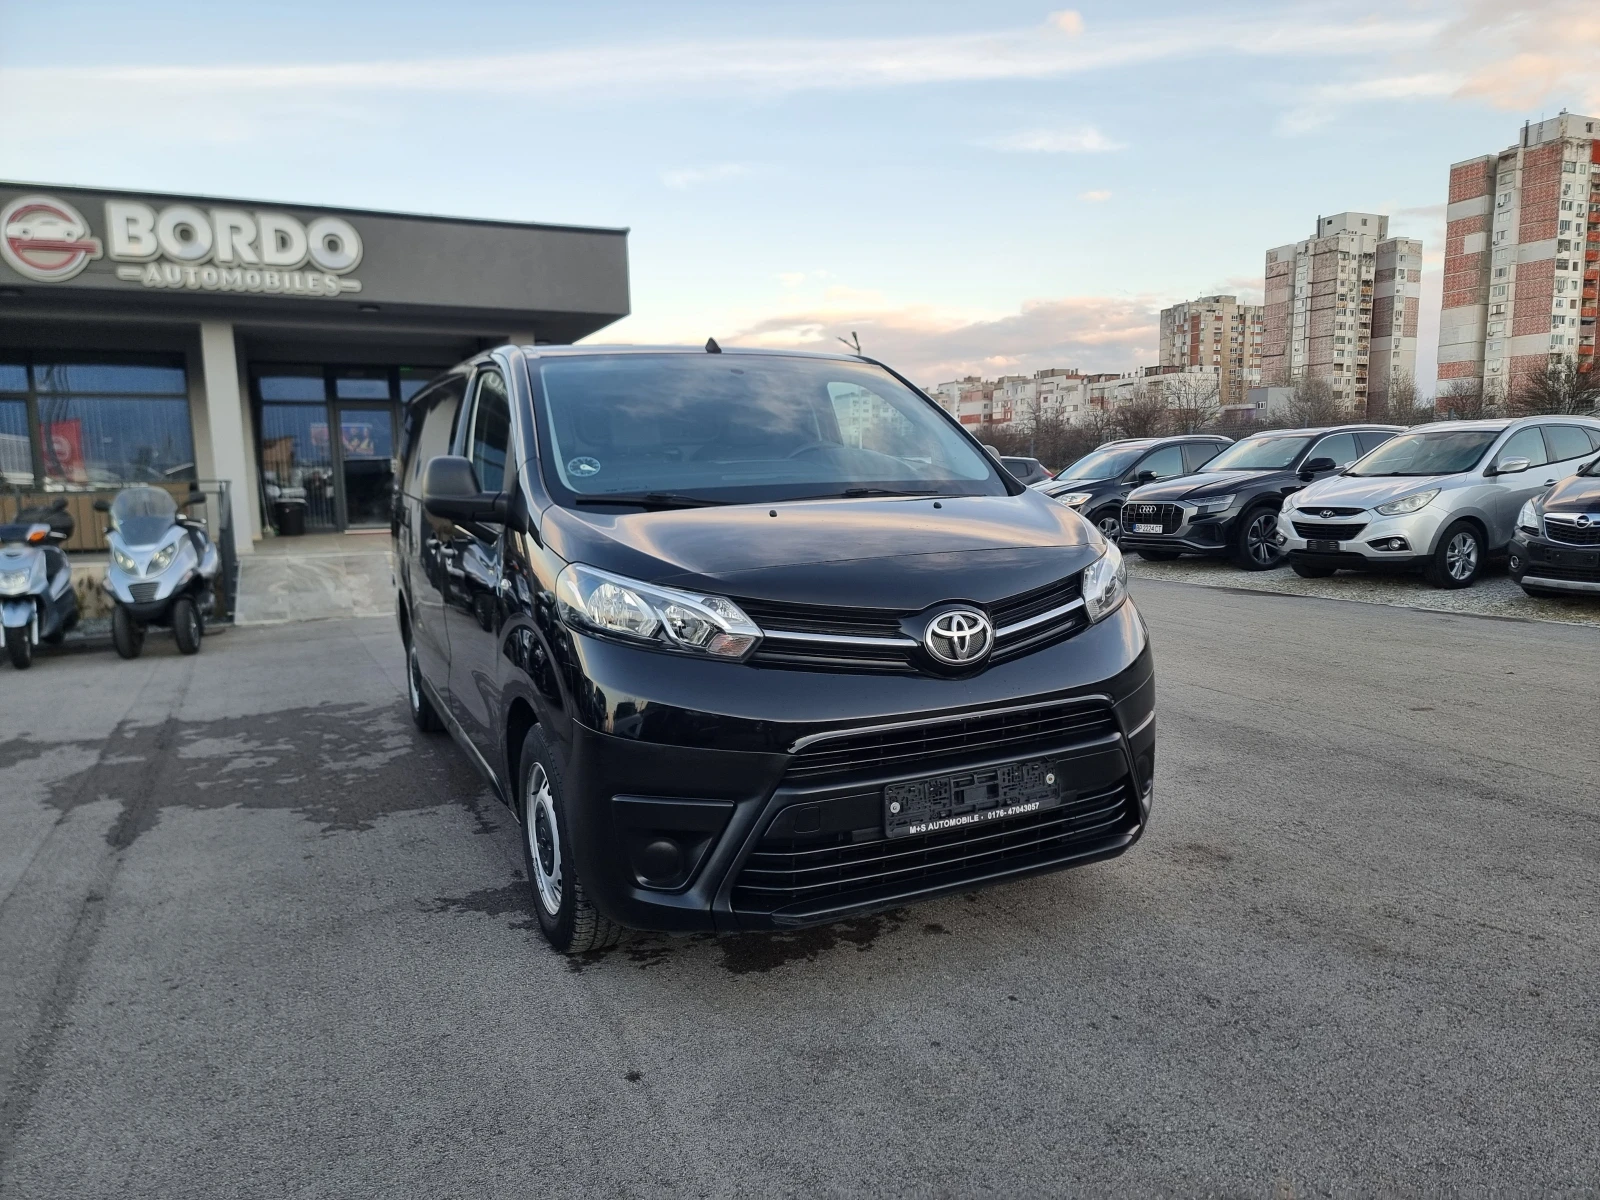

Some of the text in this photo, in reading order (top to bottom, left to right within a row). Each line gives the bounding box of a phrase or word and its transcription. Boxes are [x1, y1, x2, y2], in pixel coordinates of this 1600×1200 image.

[108, 201, 361, 272] BORDO
[145, 264, 339, 292] AUTOMOBILES
[909, 824, 926, 834] M+S
[928, 814, 979, 831] AUTOMOBILE
